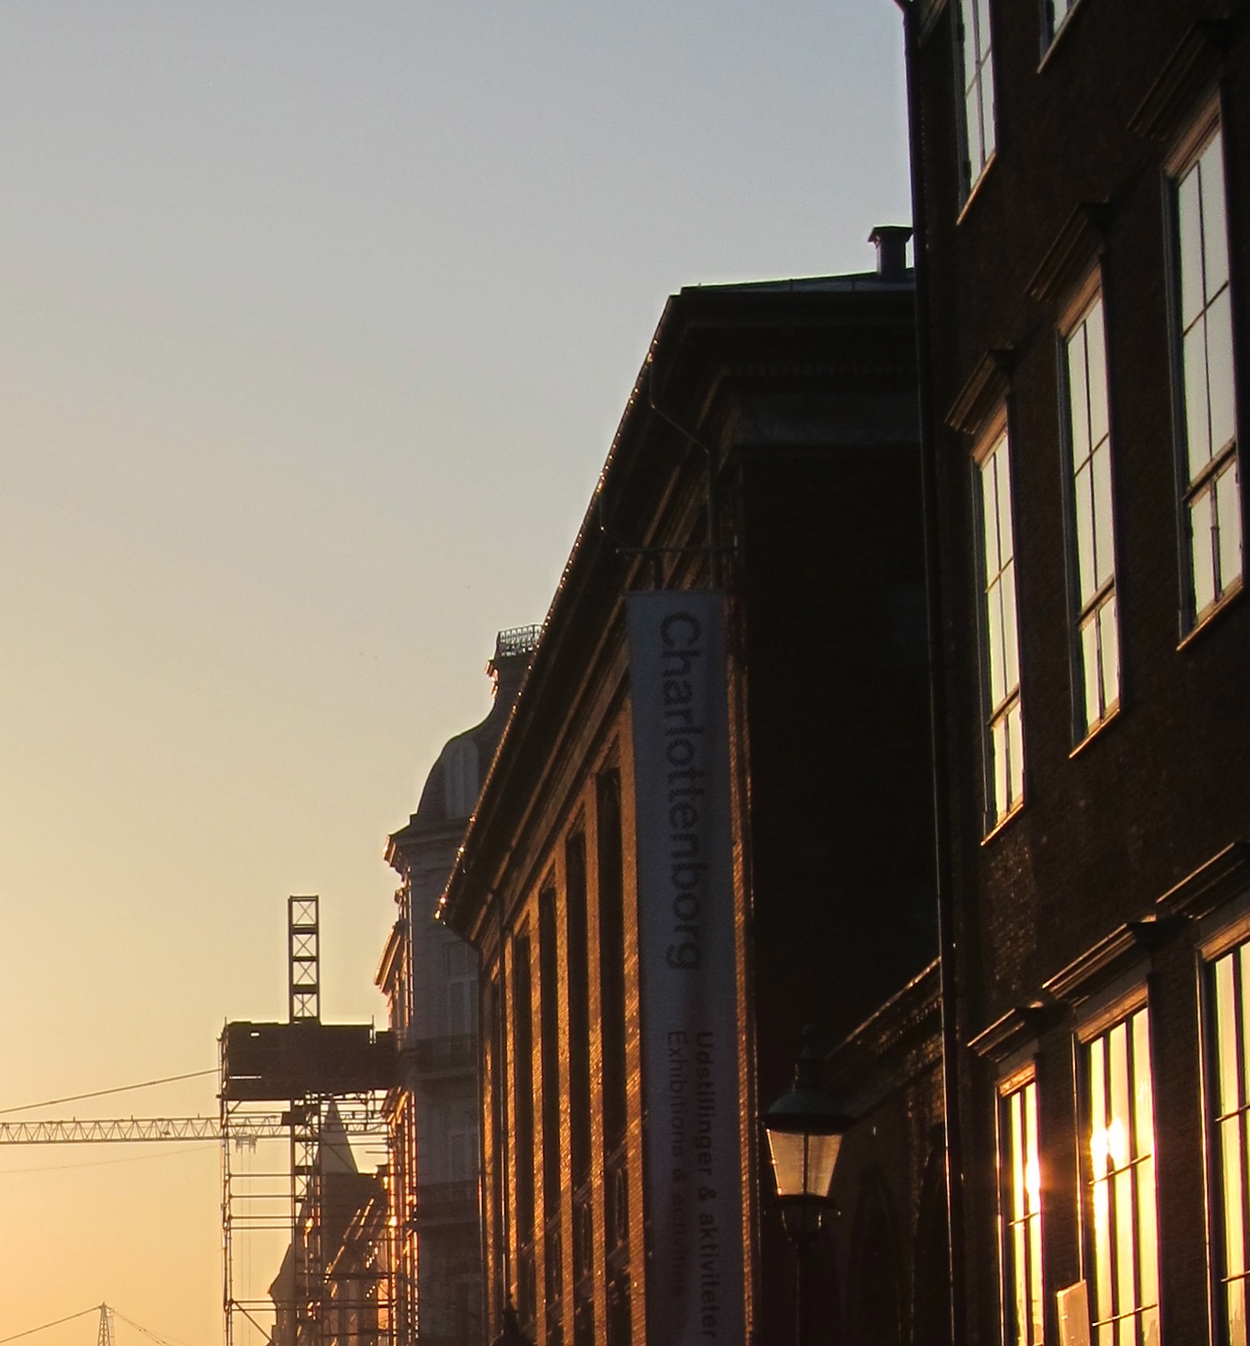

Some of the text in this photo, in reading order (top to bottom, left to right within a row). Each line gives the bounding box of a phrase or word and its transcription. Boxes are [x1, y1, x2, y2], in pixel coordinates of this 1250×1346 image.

[660, 611, 709, 971] Charlottenborg
[668, 1031, 688, 1298] Exhibitions & activities
[695, 1031, 721, 1340] Udstillinger & aktiviteter
